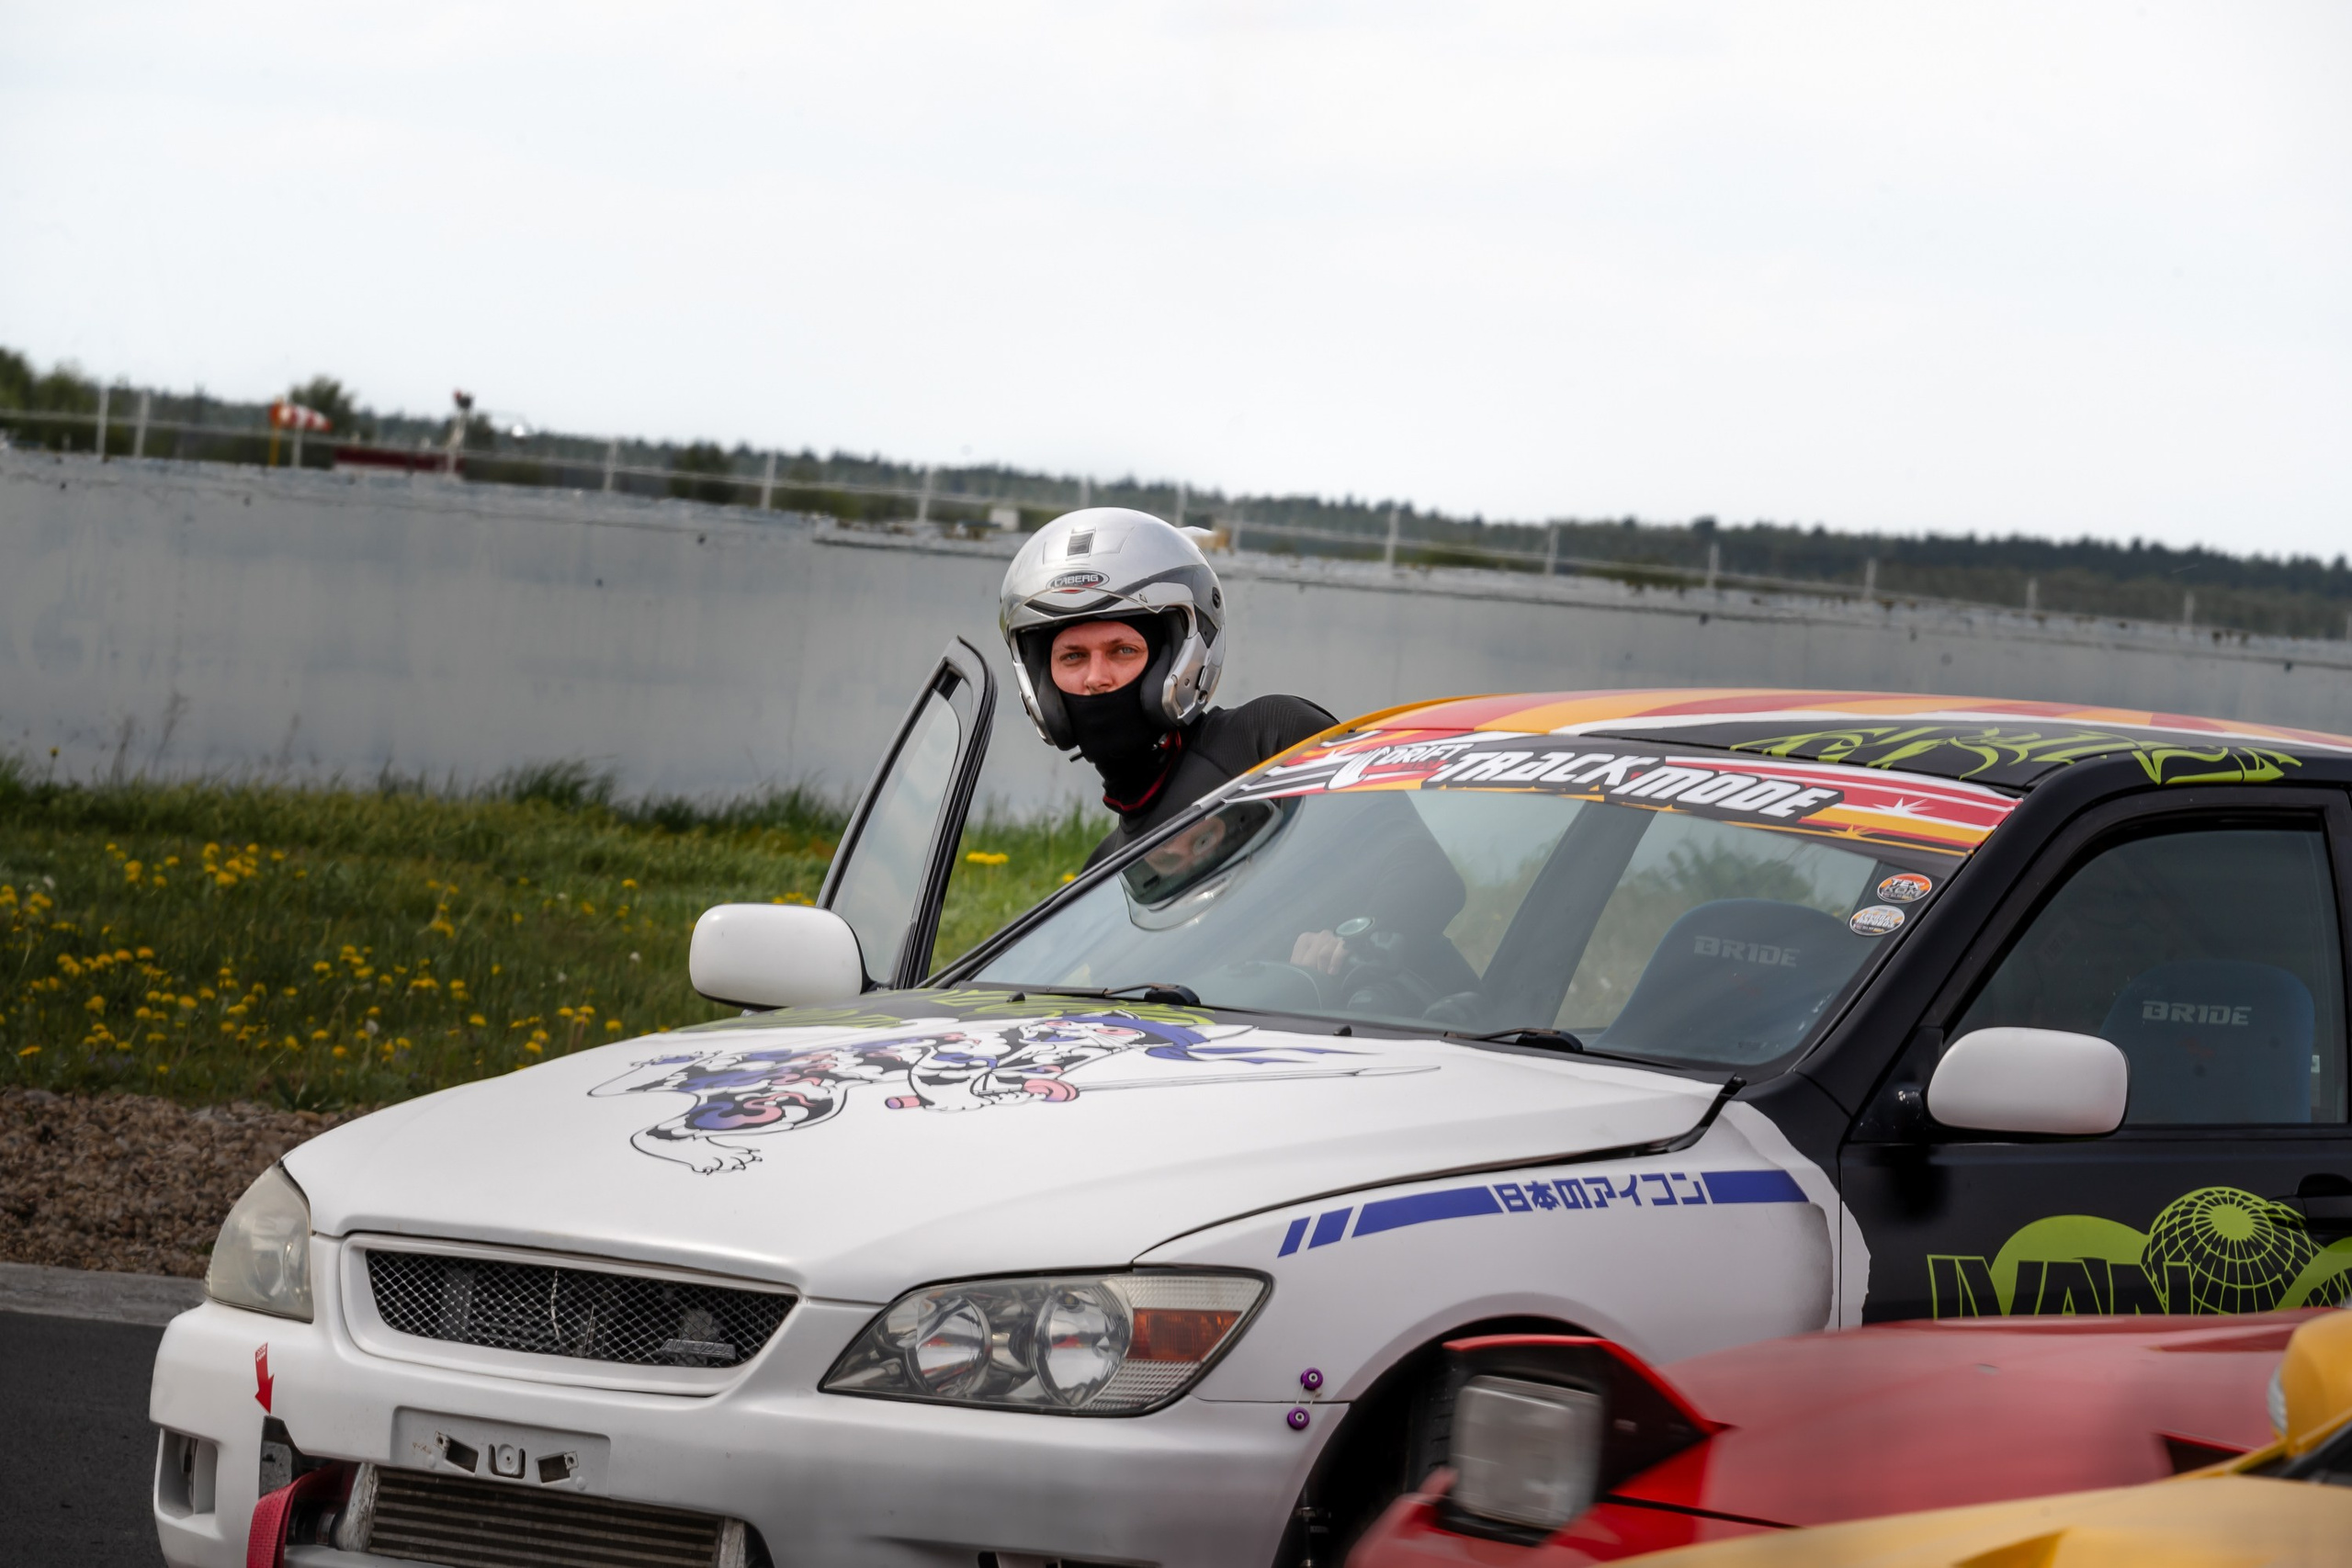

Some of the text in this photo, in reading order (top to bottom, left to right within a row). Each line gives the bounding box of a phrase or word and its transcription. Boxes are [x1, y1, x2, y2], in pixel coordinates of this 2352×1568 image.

[1377, 742, 1475, 765] DRIFT
[1693, 935, 1801, 967] BRIDE
[2142, 1000, 2252, 1025] BRIDE
[1492, 1172, 1707, 1213] 日本のアイコン
